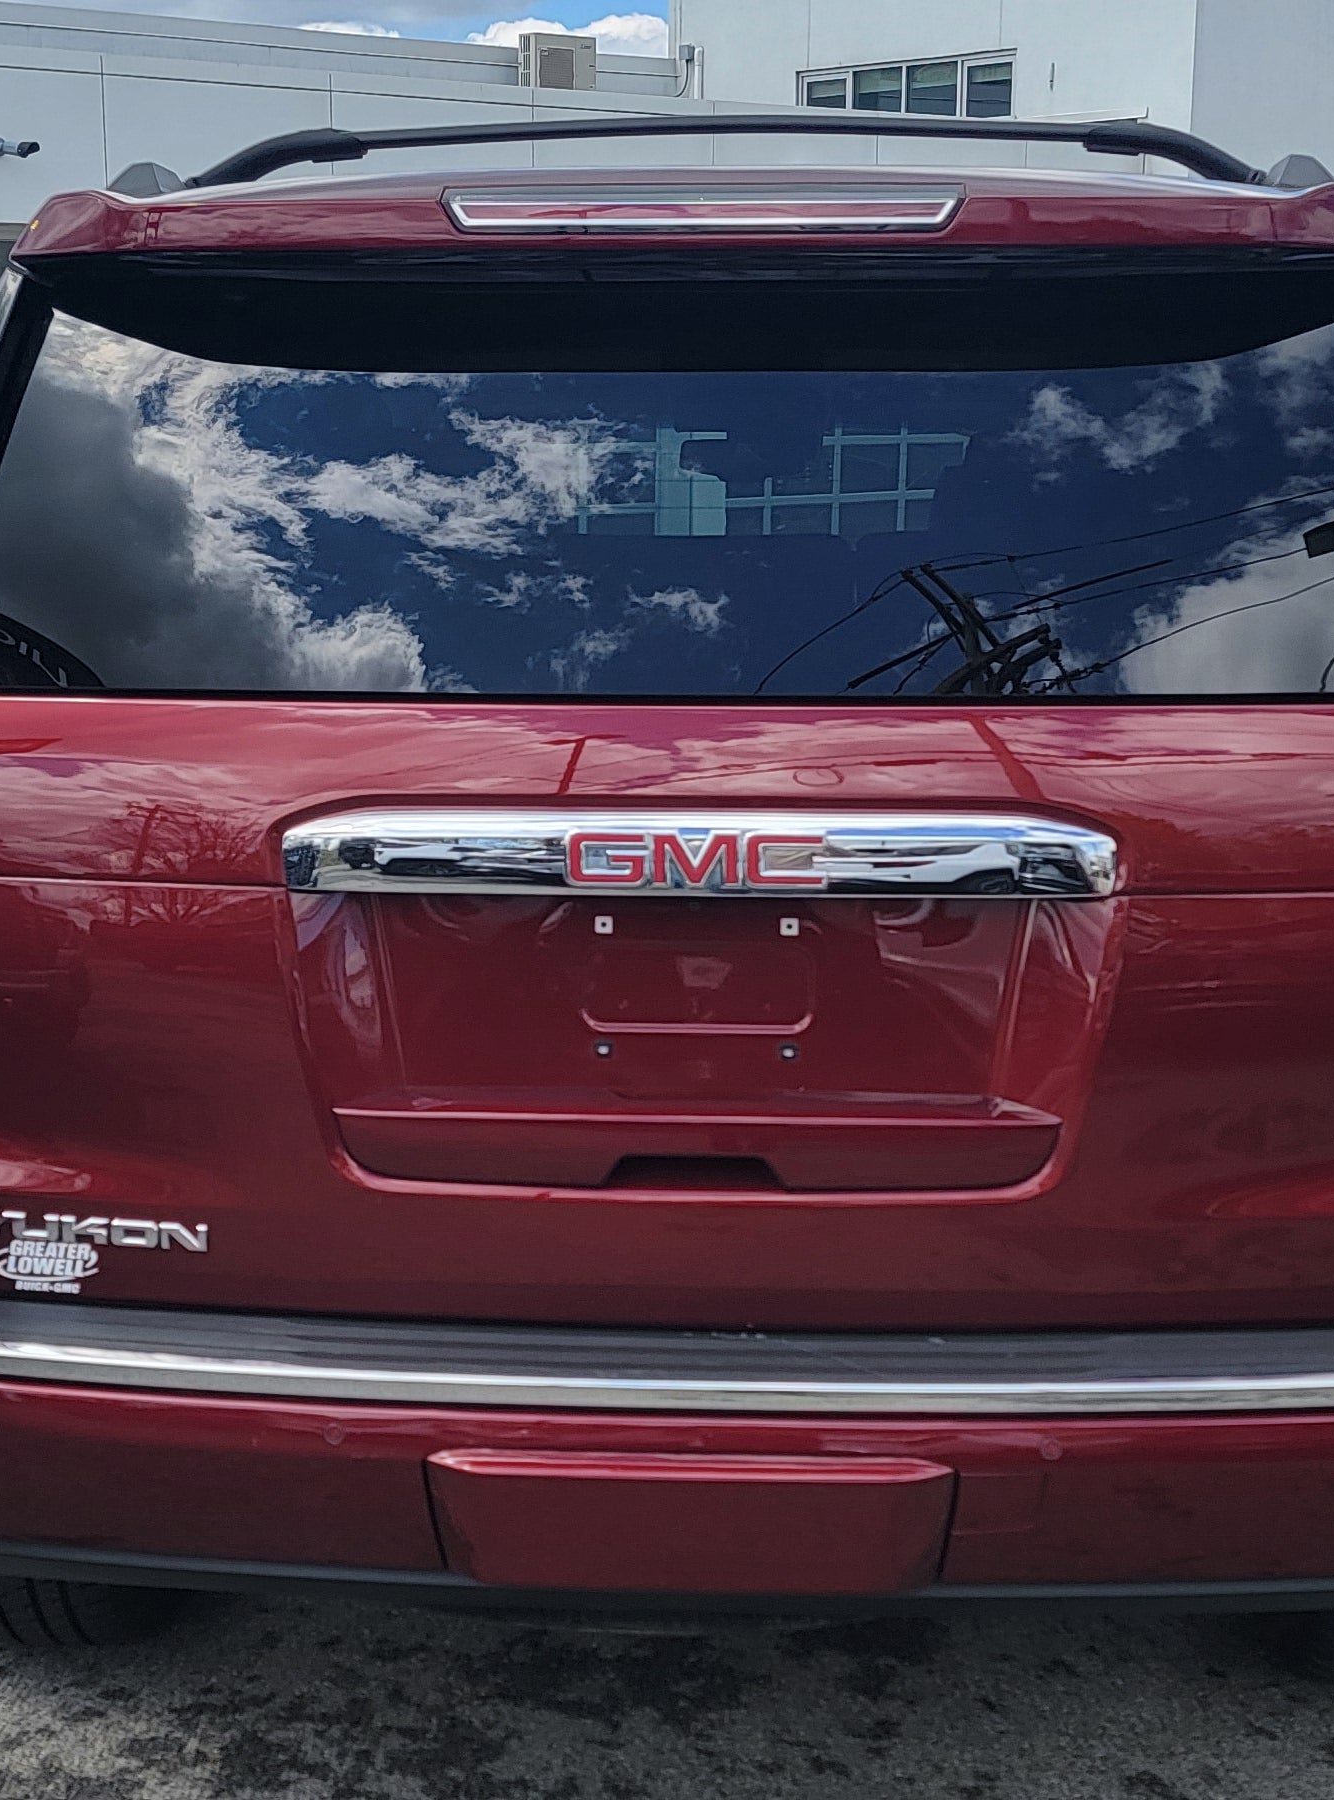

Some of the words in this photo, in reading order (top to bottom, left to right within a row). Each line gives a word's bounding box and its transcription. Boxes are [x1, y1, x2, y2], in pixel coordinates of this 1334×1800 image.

[565, 829, 828, 890] GMC
[9, 1239, 92, 1261] GREATER
[6, 1256, 85, 1278] LOWELL
